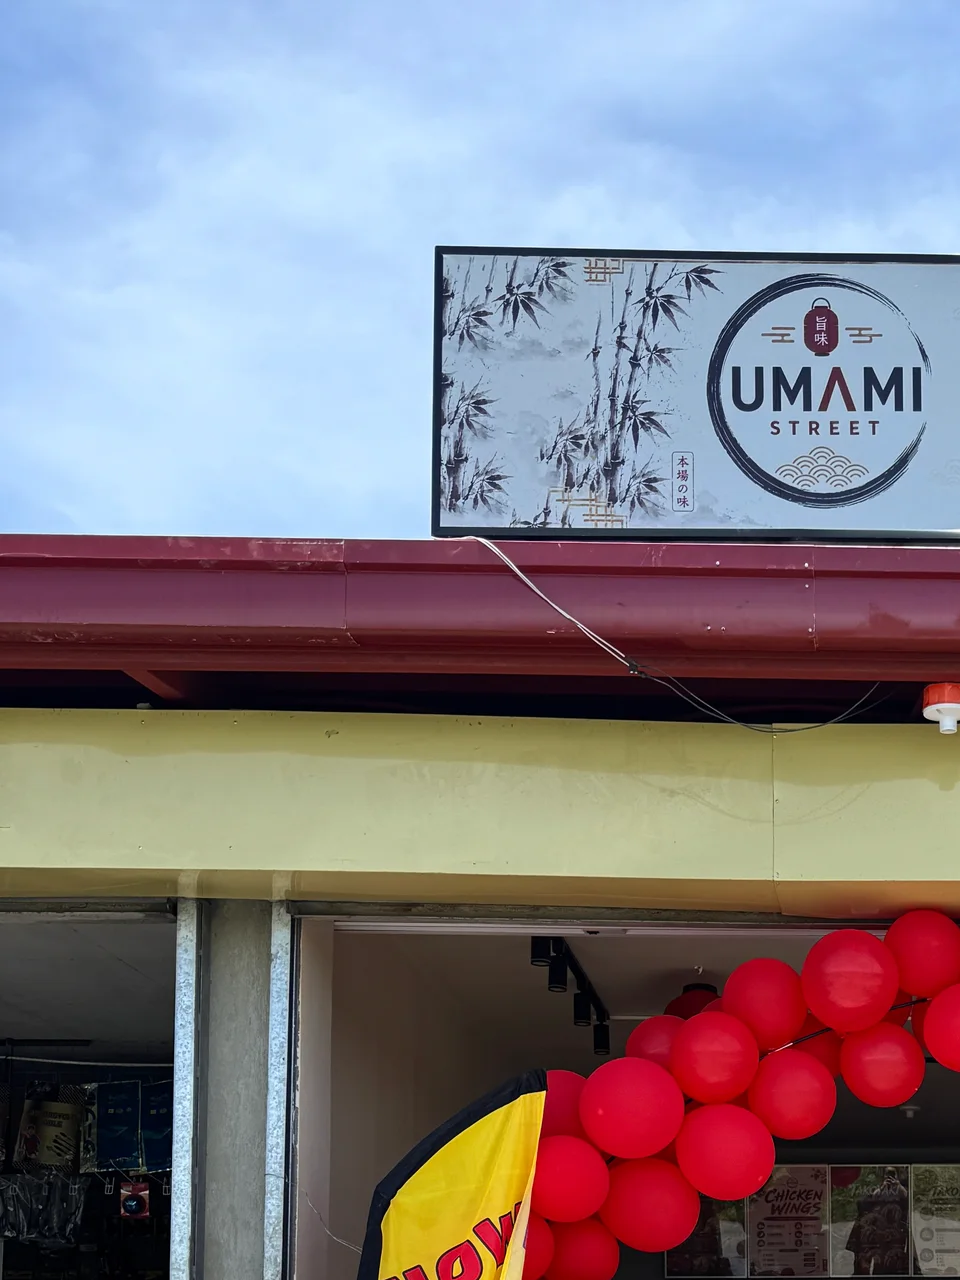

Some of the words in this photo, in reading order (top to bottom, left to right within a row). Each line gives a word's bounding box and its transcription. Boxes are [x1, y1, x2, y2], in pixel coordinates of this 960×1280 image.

[813, 315, 830, 347] 旨味
[732, 366, 922, 412] UMAMI
[770, 420, 880, 436] STREET
[676, 455, 690, 508] 本場の味
[764, 1188, 824, 1204] CHICKEN
[770, 1202, 822, 1215] WINGS
